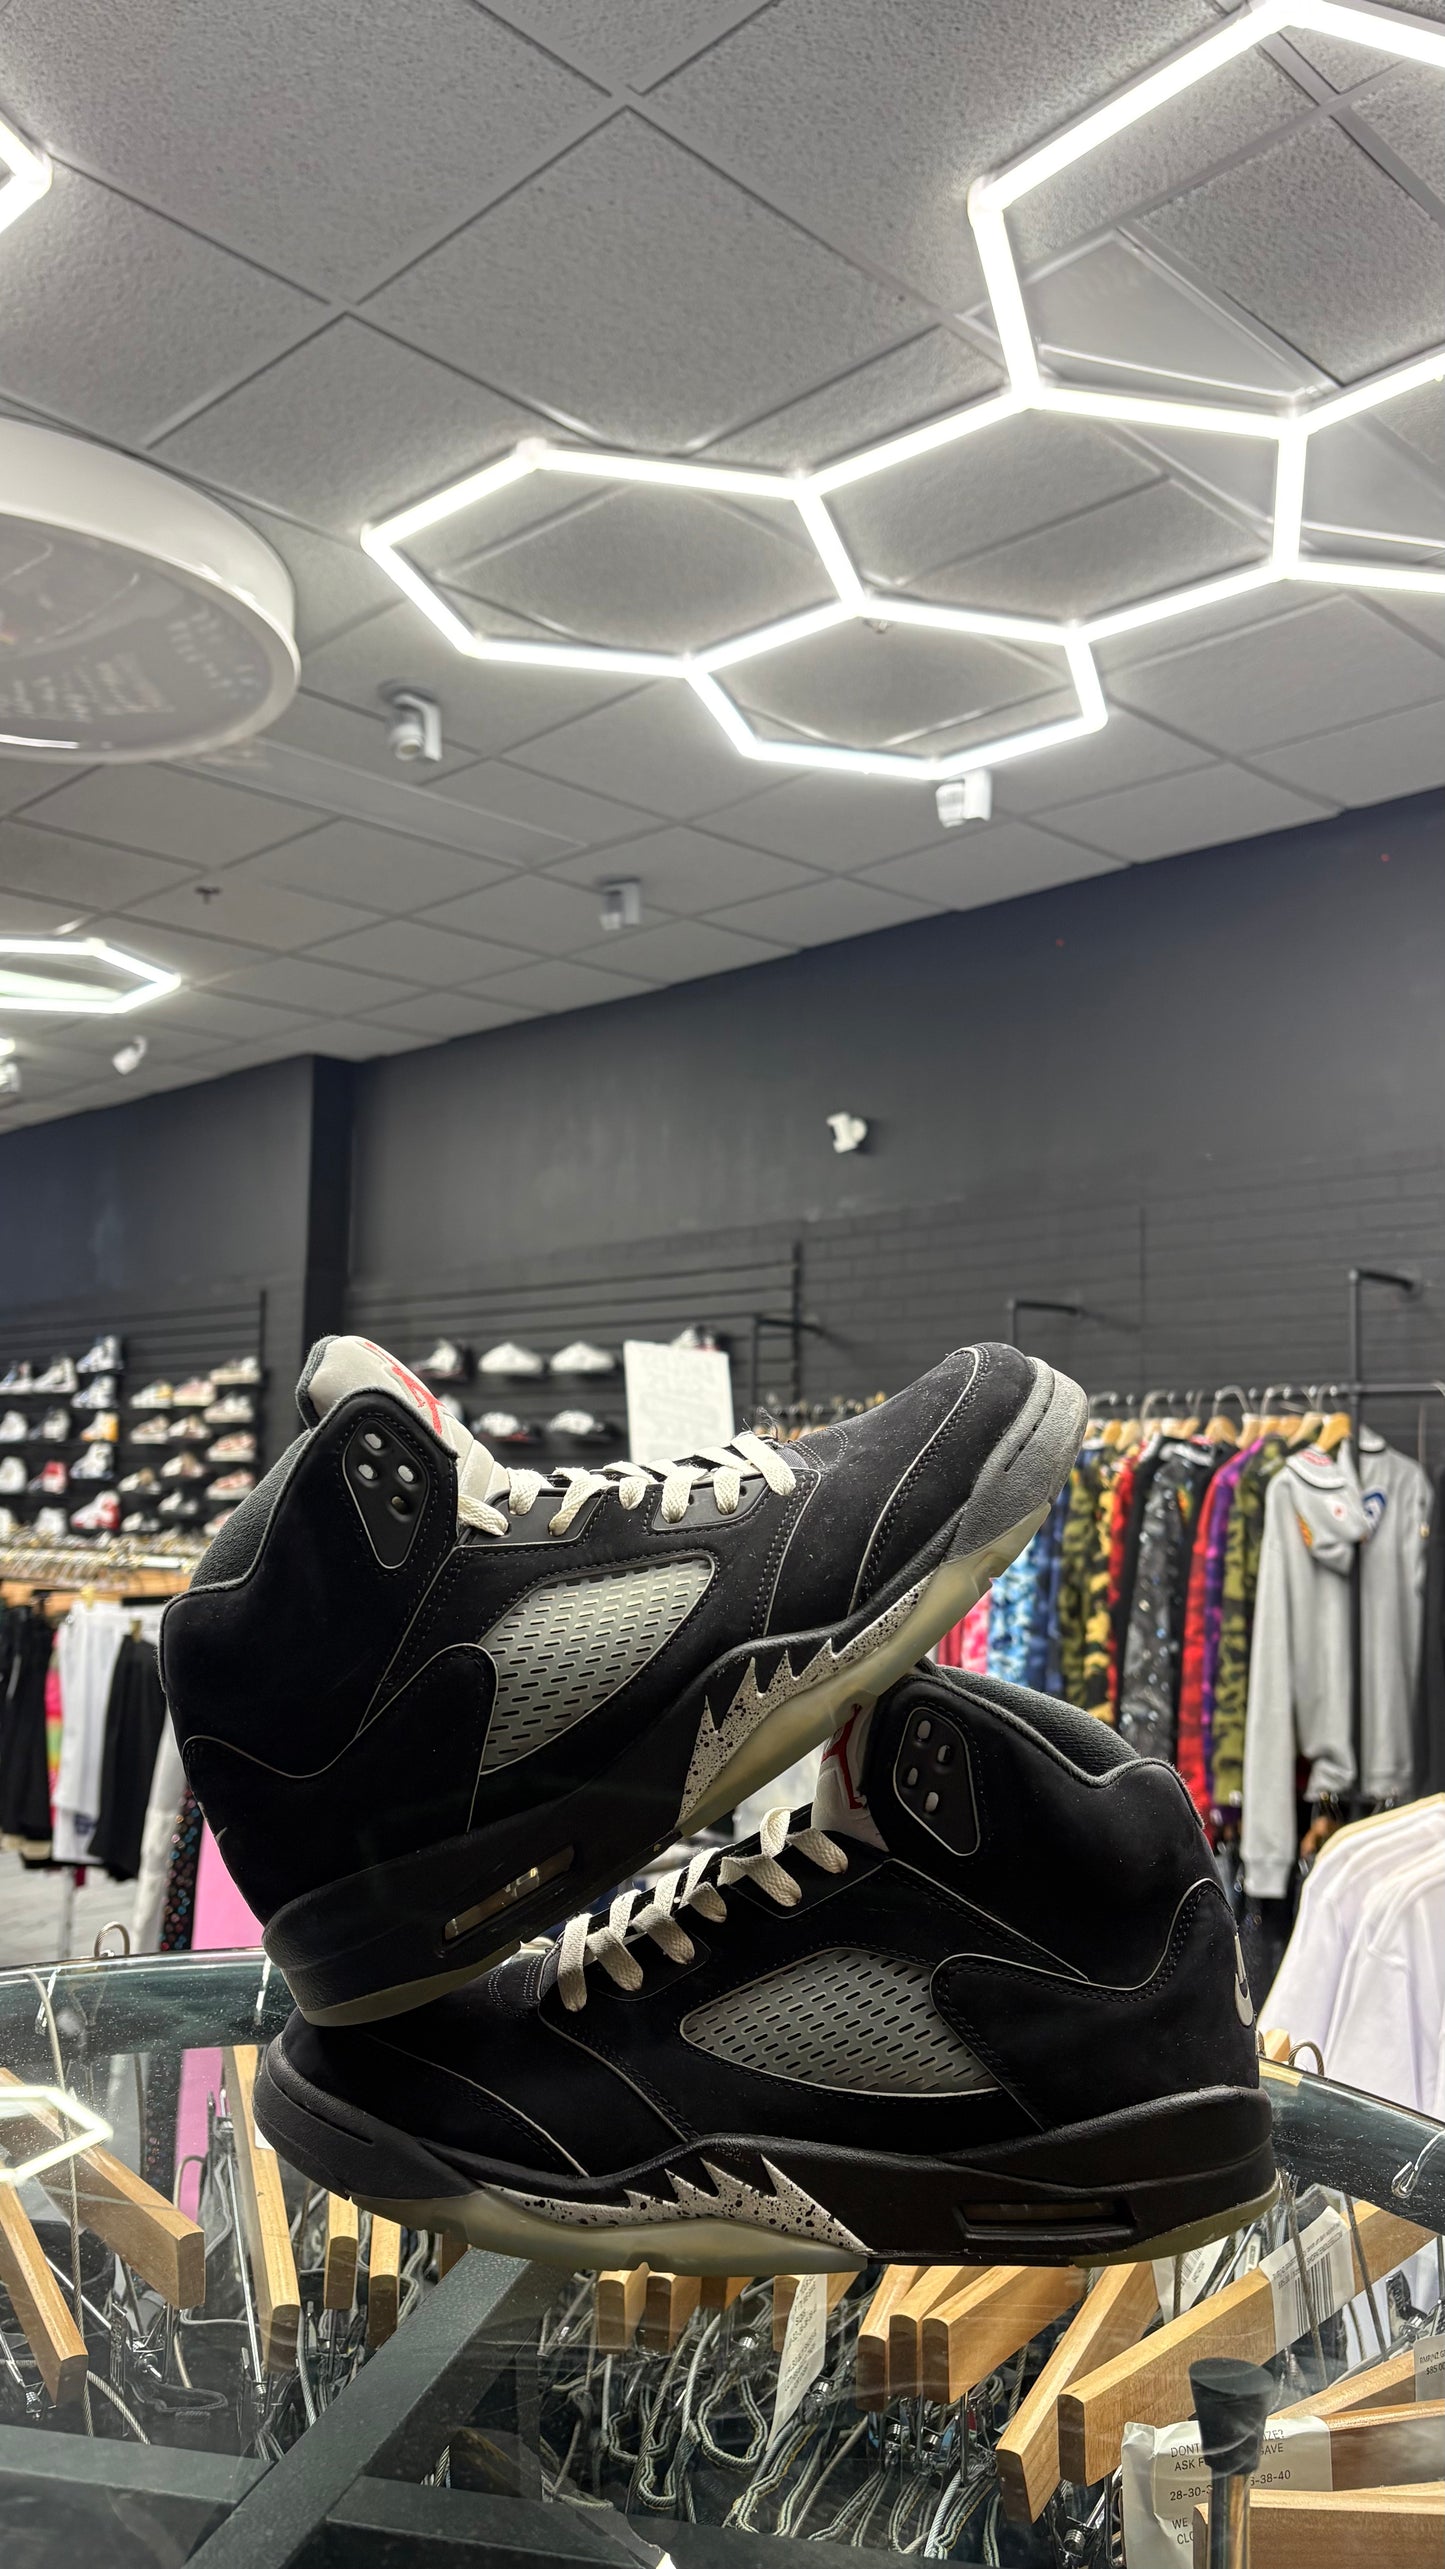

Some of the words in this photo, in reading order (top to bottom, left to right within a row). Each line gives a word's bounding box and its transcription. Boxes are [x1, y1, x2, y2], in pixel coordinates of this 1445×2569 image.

[1170, 2442, 1200, 2458] DONT
[1174, 2458, 1195, 2472] ASK
[1171, 2517, 1188, 2530] WE
